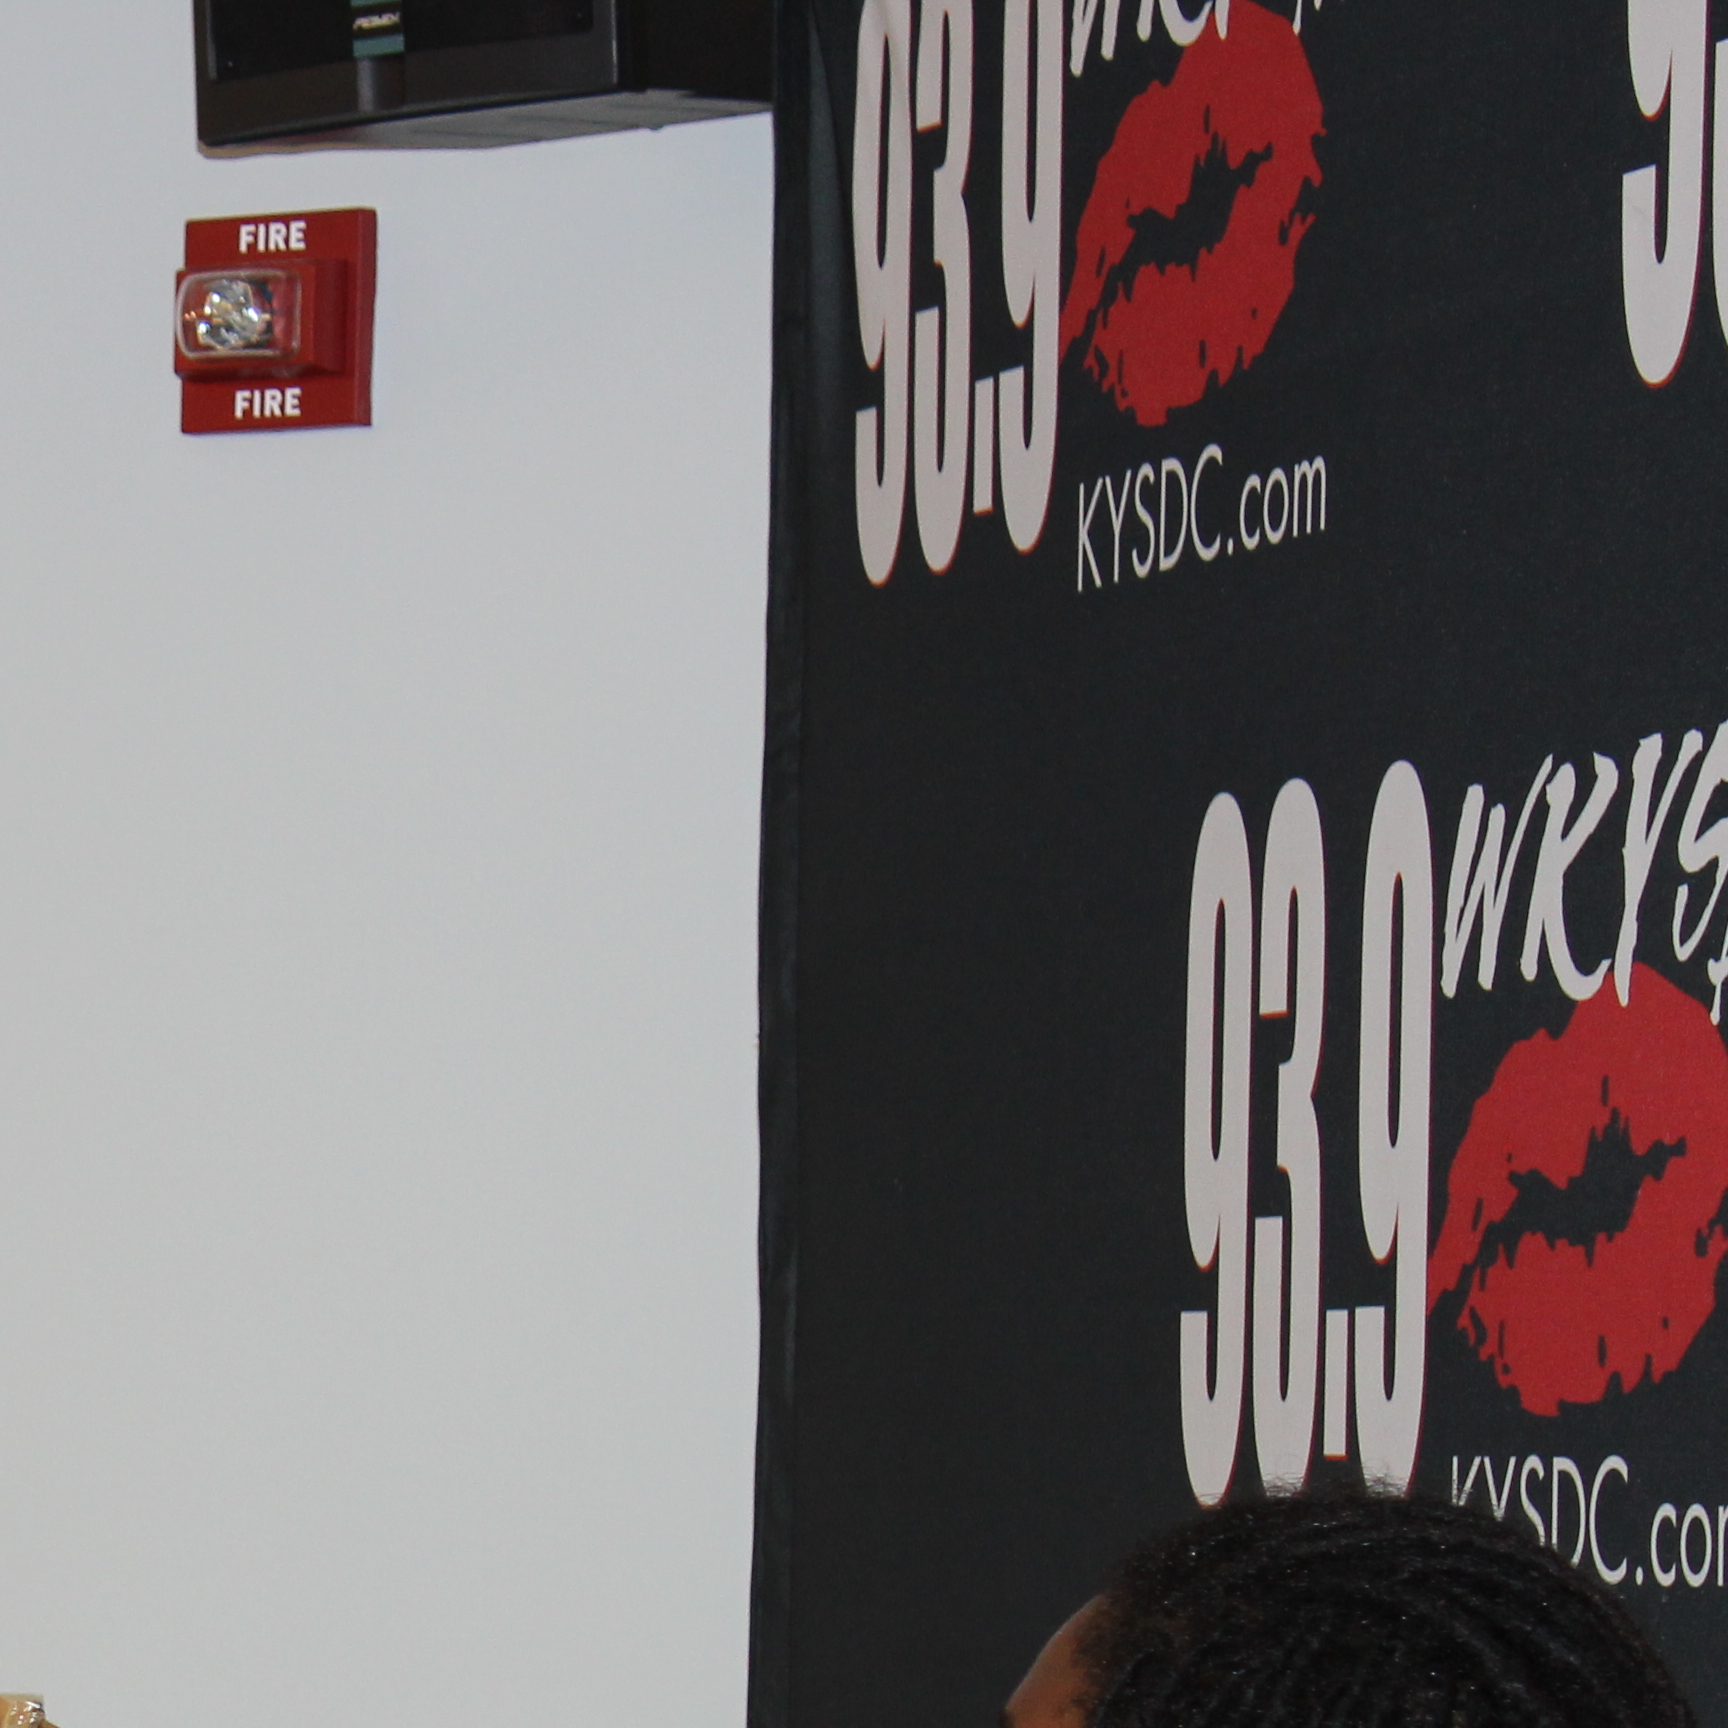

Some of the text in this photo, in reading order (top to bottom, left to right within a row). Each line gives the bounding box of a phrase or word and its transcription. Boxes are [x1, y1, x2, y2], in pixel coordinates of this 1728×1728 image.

[238, 221, 307, 253] FIRE
[852, 0, 1063, 587] 93.9
[233, 387, 302, 420] FIRE
[1076, 443, 1328, 593] KYSDC.com
[1180, 760, 1434, 1508] 93.9
